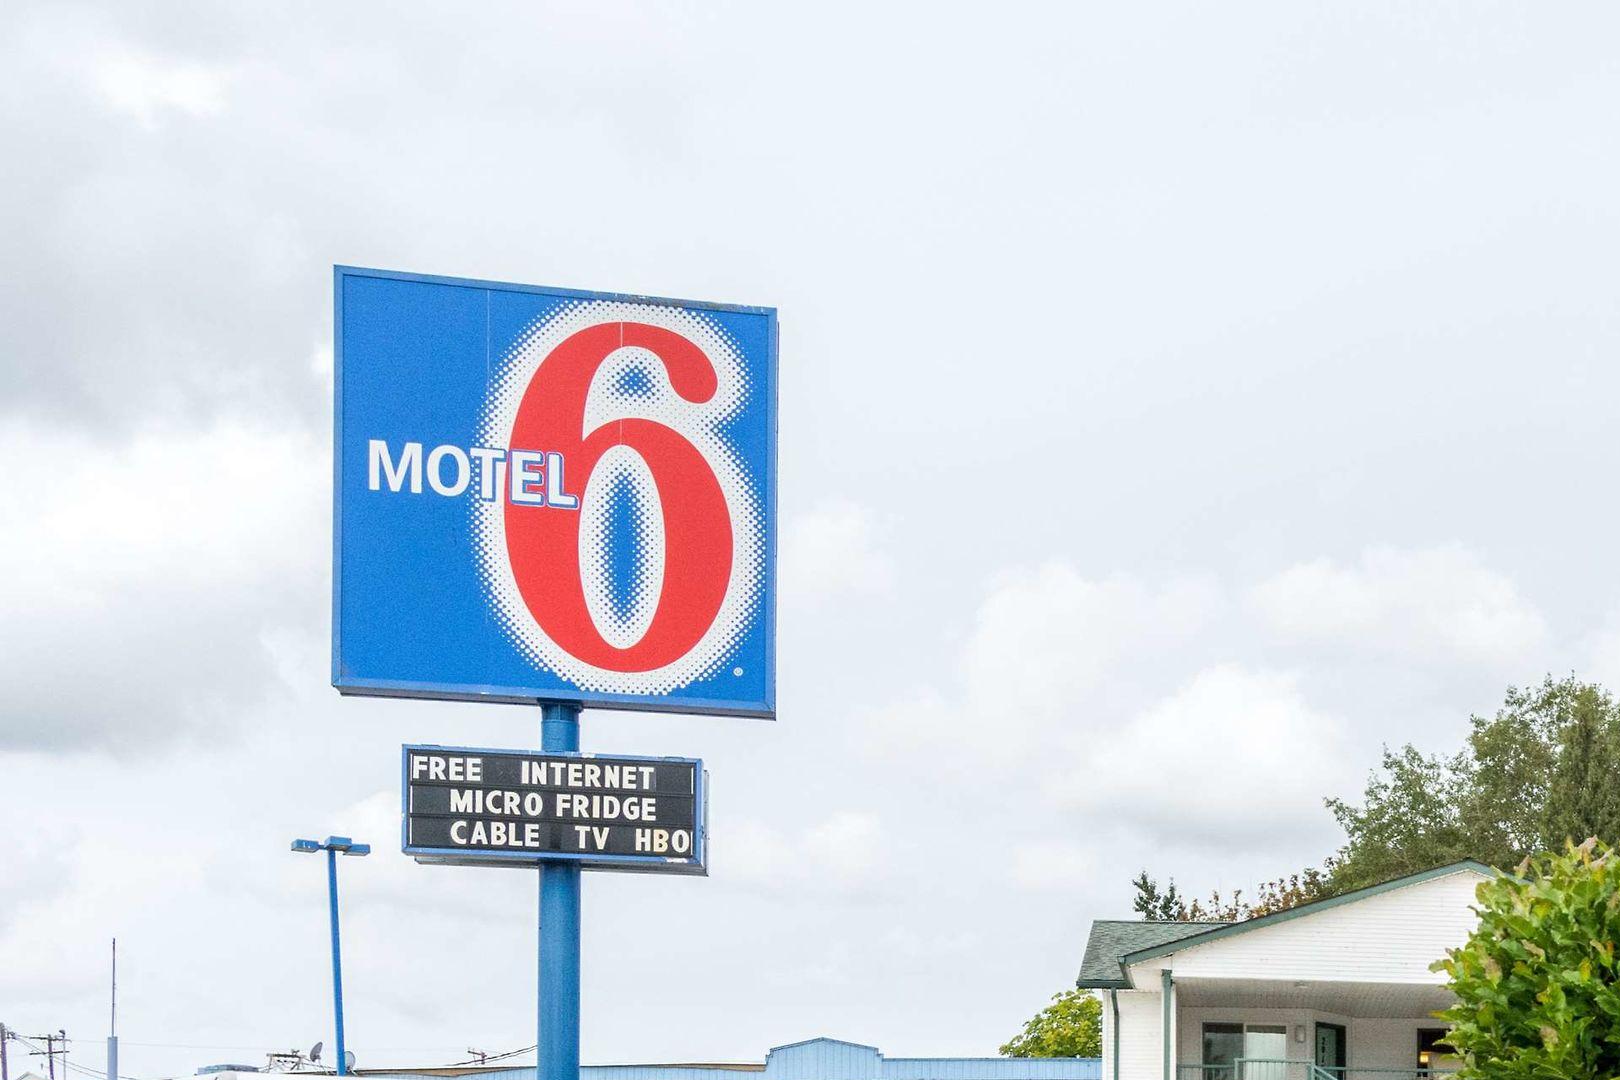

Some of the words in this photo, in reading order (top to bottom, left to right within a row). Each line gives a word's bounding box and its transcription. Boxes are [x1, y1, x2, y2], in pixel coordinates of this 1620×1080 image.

[367, 438, 580, 510] MOTEL
[503, 321, 734, 674] 6
[412, 755, 482, 781] FREE
[521, 760, 655, 790] INTERNET
[450, 789, 543, 817] MICRO
[556, 793, 656, 822] FRIDGE
[450, 821, 540, 848] CABLE
[574, 825, 610, 850] TV
[635, 828, 690, 853] HBO
